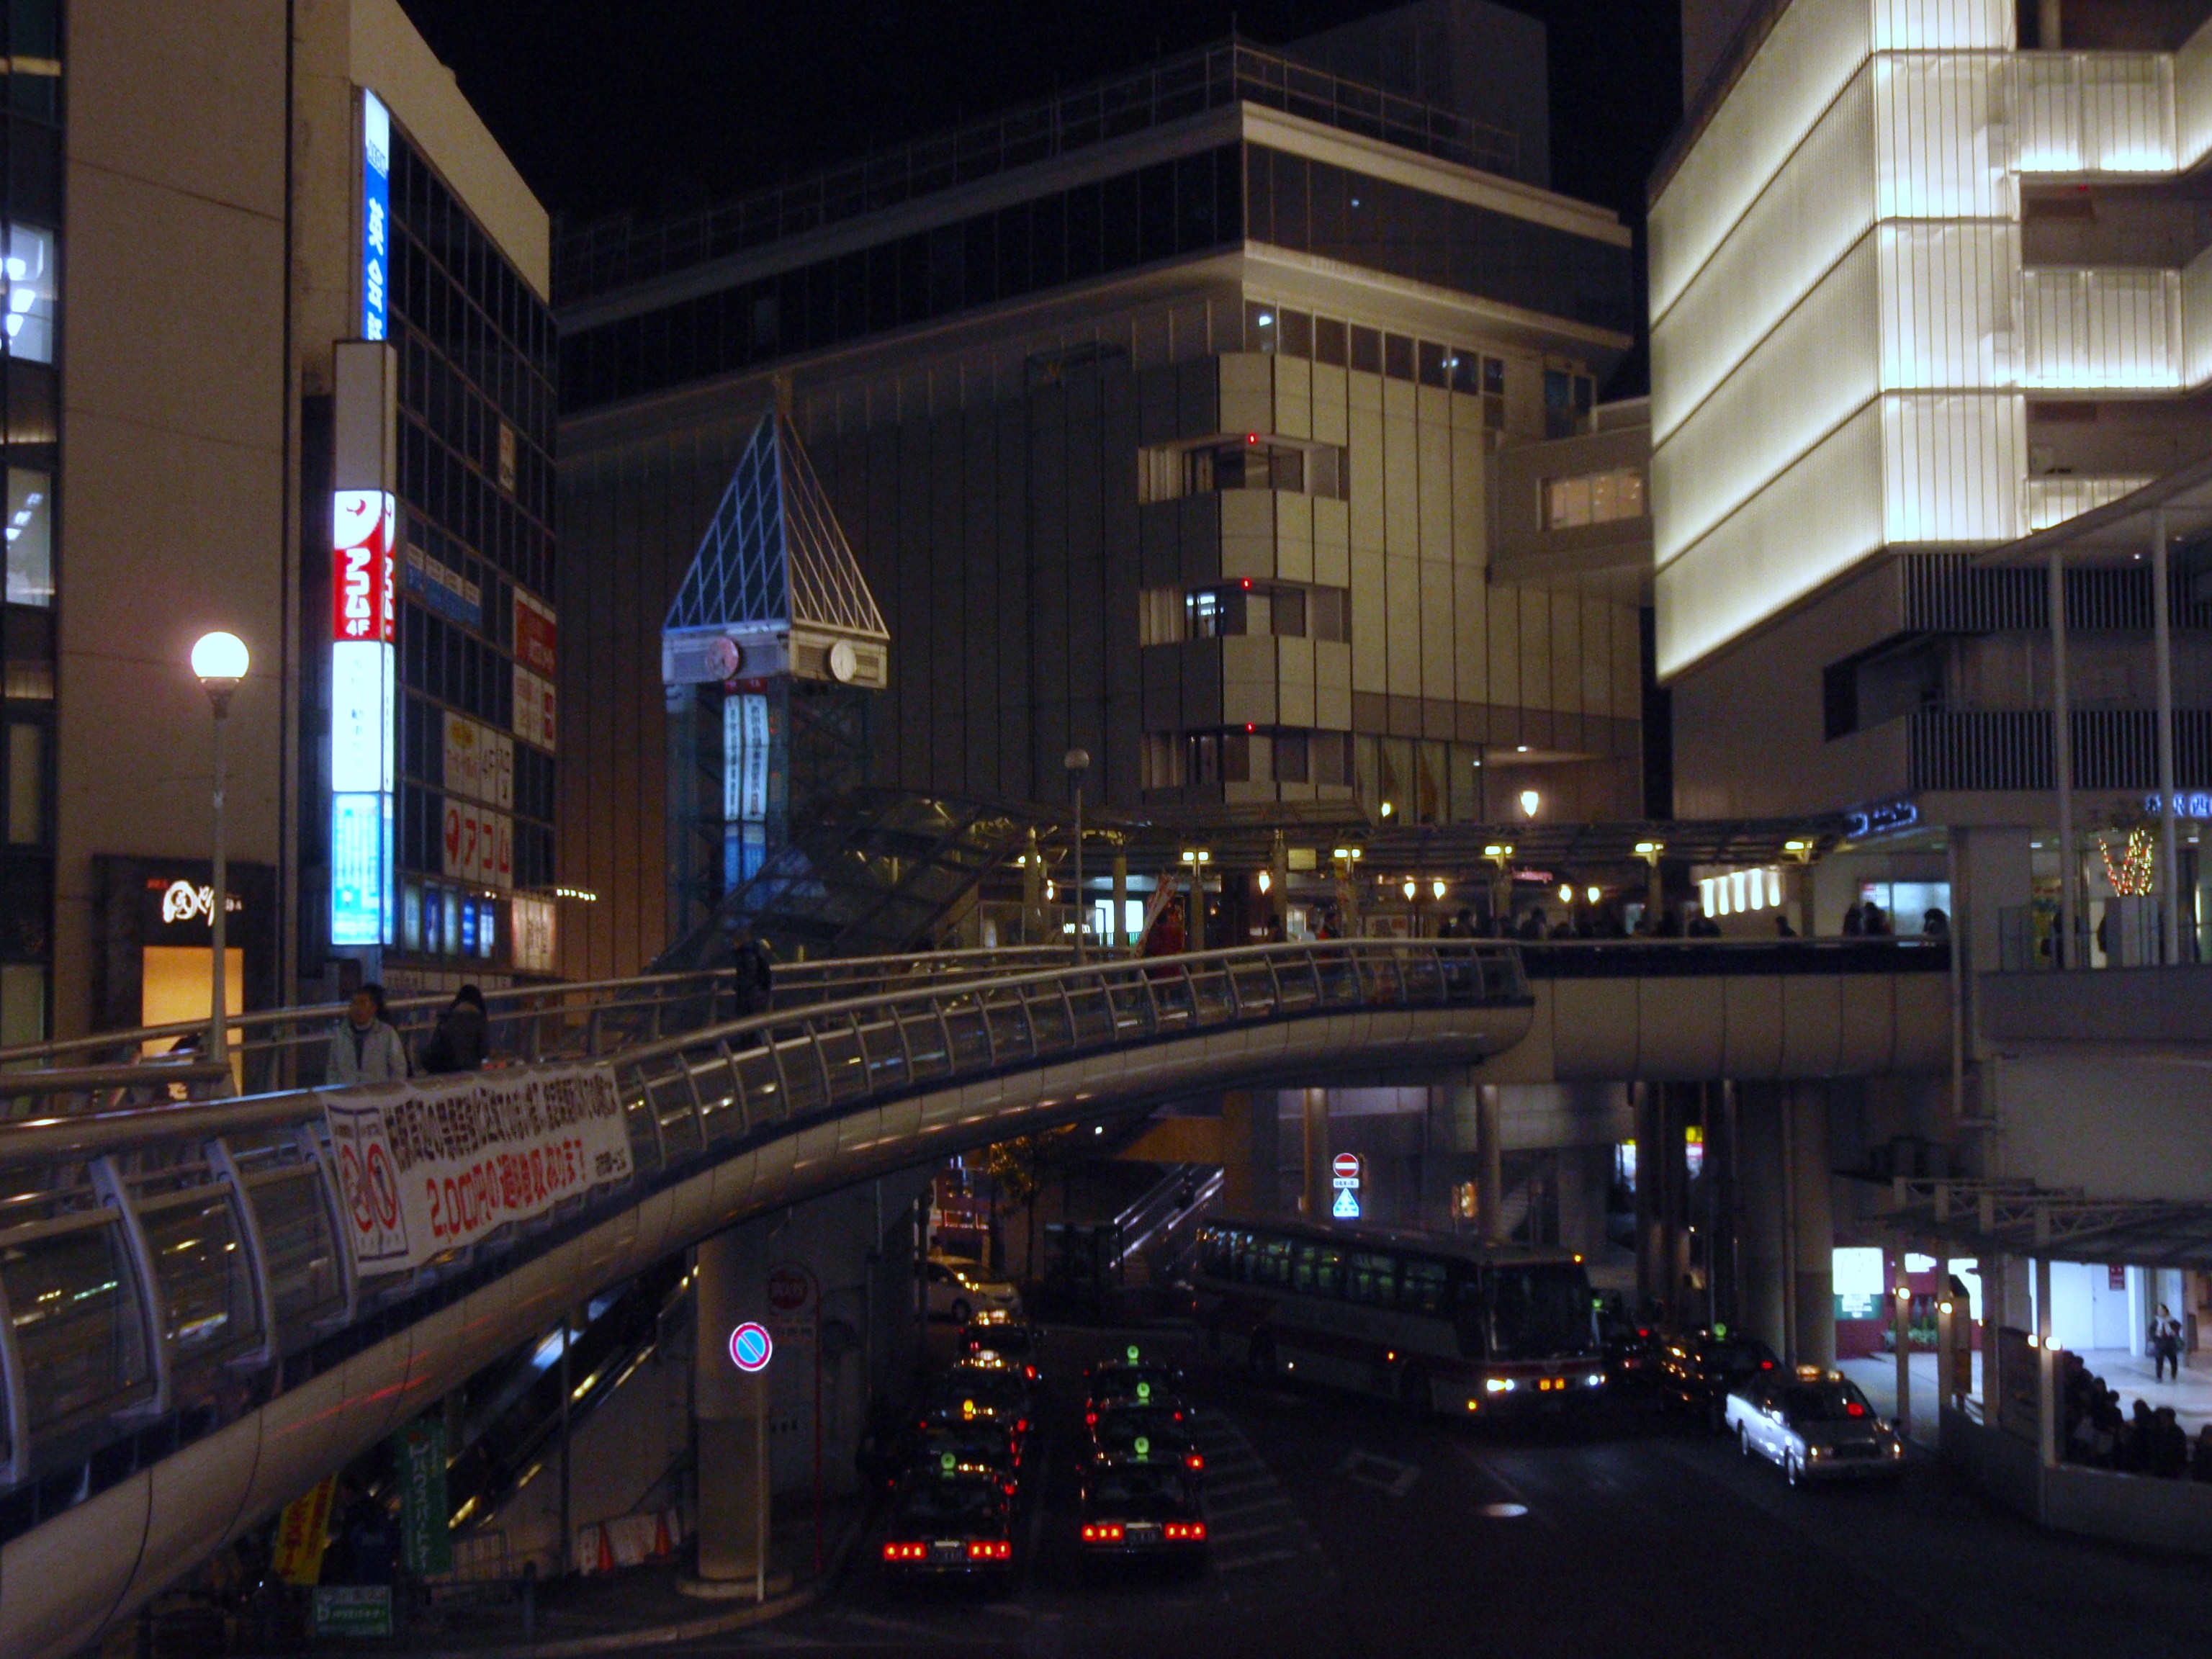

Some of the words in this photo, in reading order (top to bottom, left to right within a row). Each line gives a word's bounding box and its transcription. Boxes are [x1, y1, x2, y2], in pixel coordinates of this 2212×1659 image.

[346, 547, 371, 619] アコム
[345, 619, 371, 637] 4F
[463, 818, 510, 874] アコム
